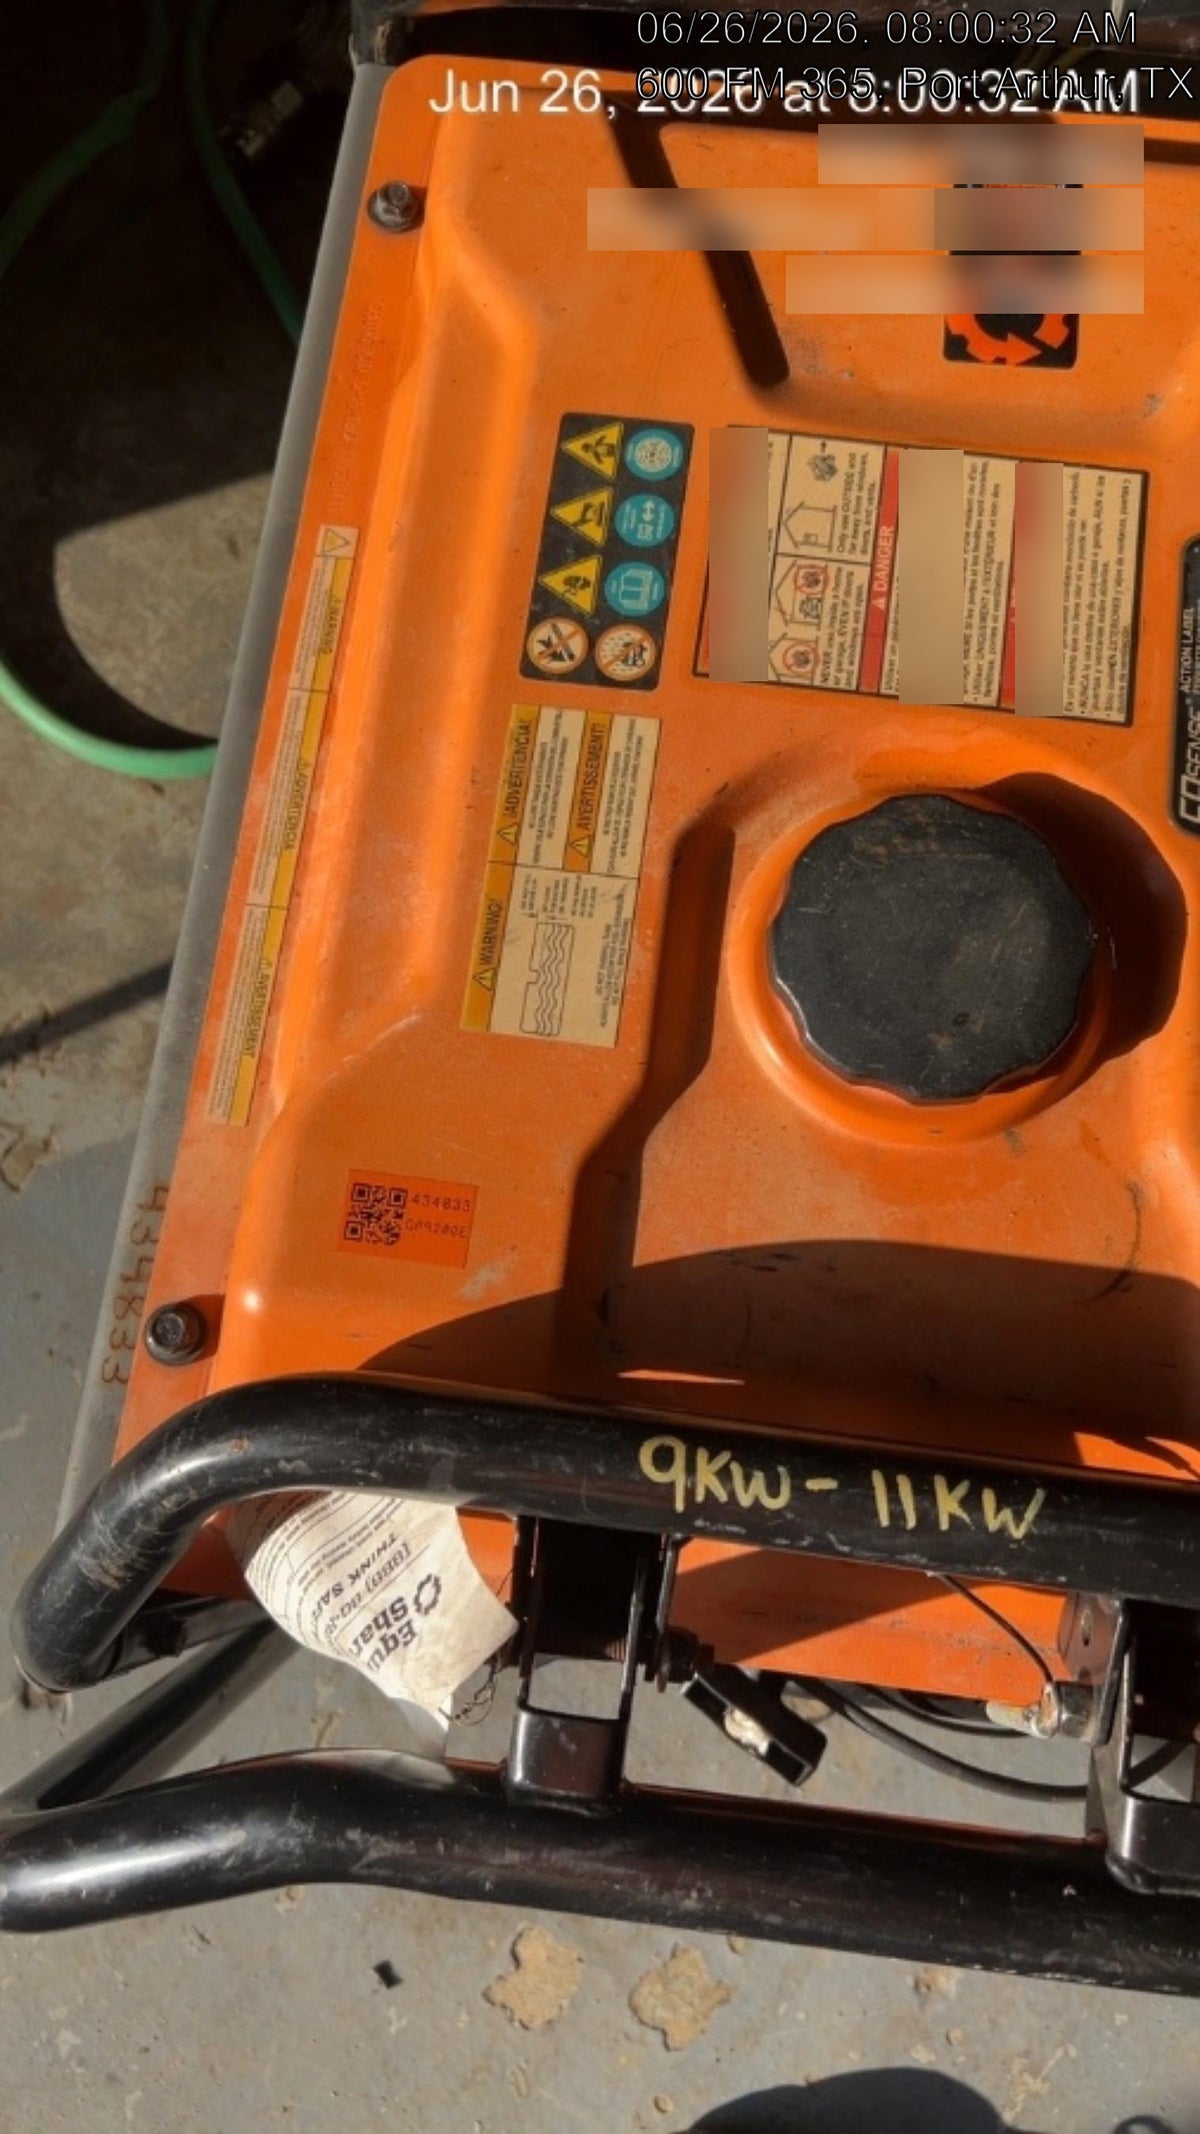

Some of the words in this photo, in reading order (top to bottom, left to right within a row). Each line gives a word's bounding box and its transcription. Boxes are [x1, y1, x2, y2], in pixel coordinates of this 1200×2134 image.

[875, 525, 894, 595] DANGER
[1182, 607, 1194, 643] LABEL
[1179, 646, 1192, 693] ACTION
[479, 898, 502, 966] WARNING!
[412, 1194, 470, 1213] 434833
[349, 1533, 399, 1585] THINK
